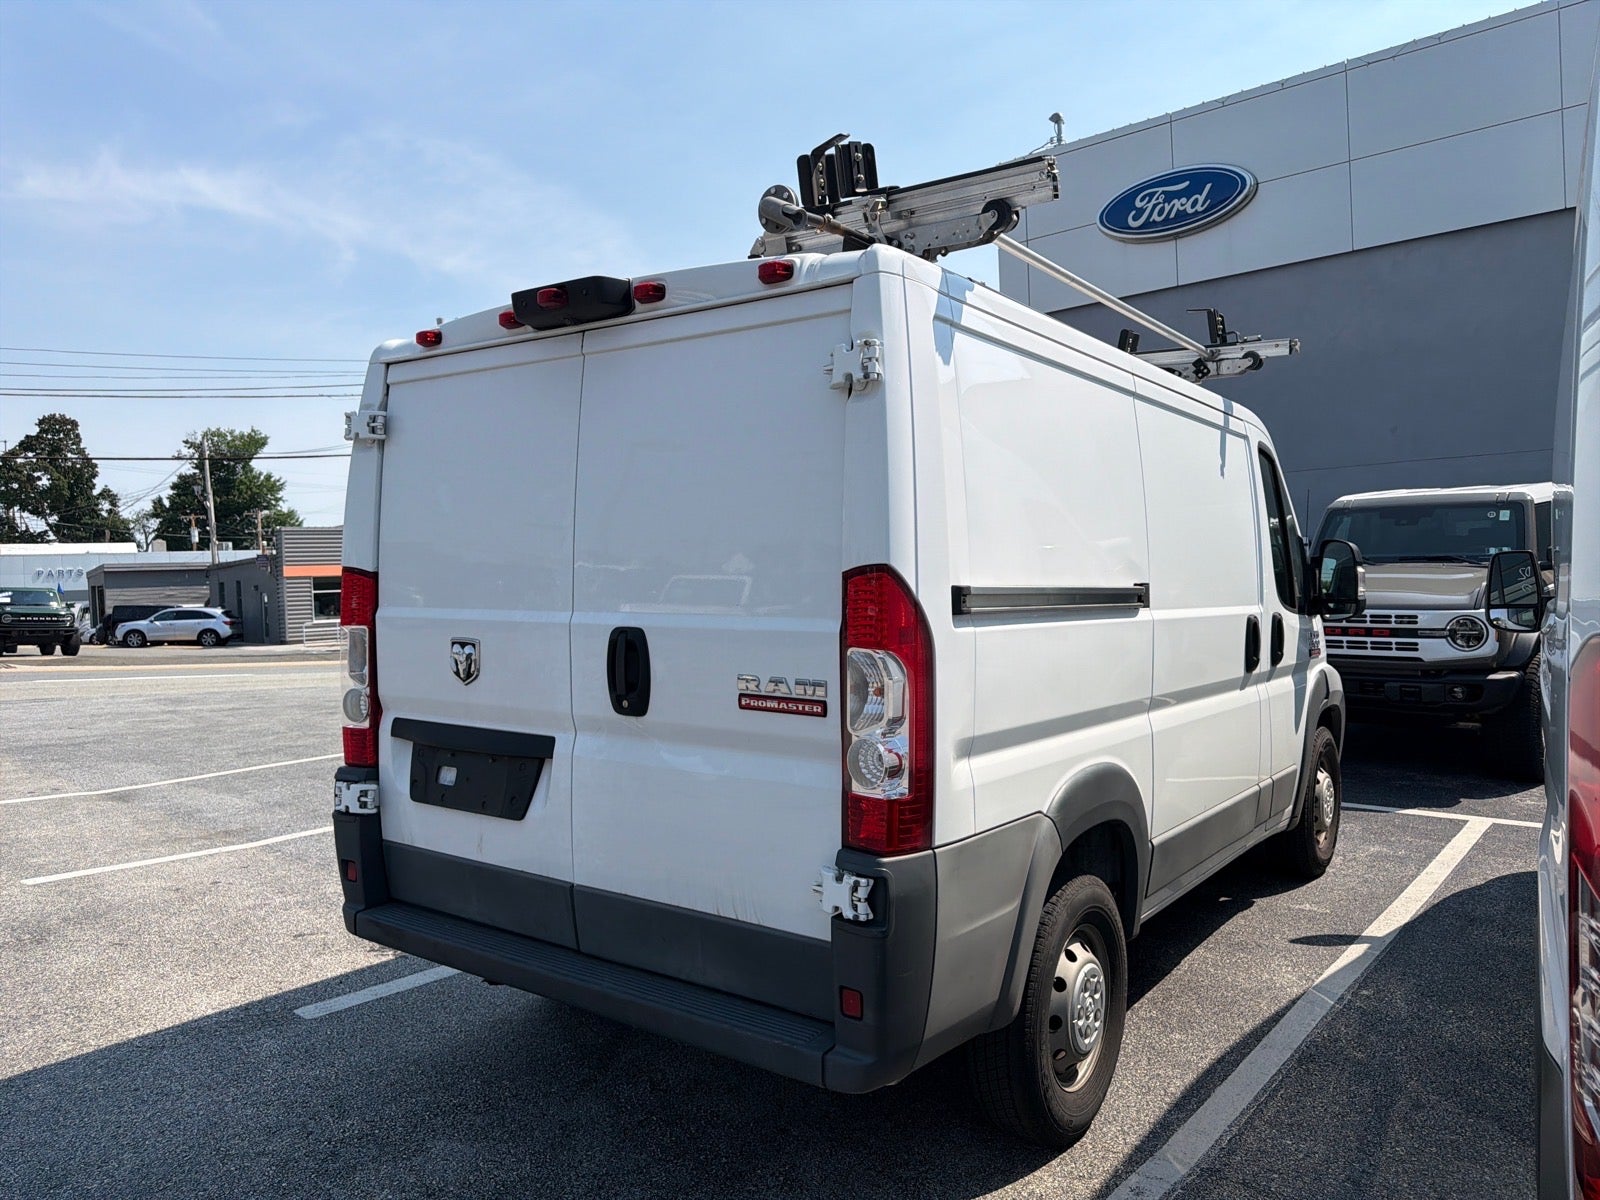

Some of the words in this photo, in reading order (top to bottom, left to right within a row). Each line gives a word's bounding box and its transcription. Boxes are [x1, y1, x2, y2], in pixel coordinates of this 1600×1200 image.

[1127, 180, 1213, 228] Ford
[37, 568, 84, 577] PARTS
[737, 674, 828, 698] RAM
[741, 697, 822, 713] PROMASTER
